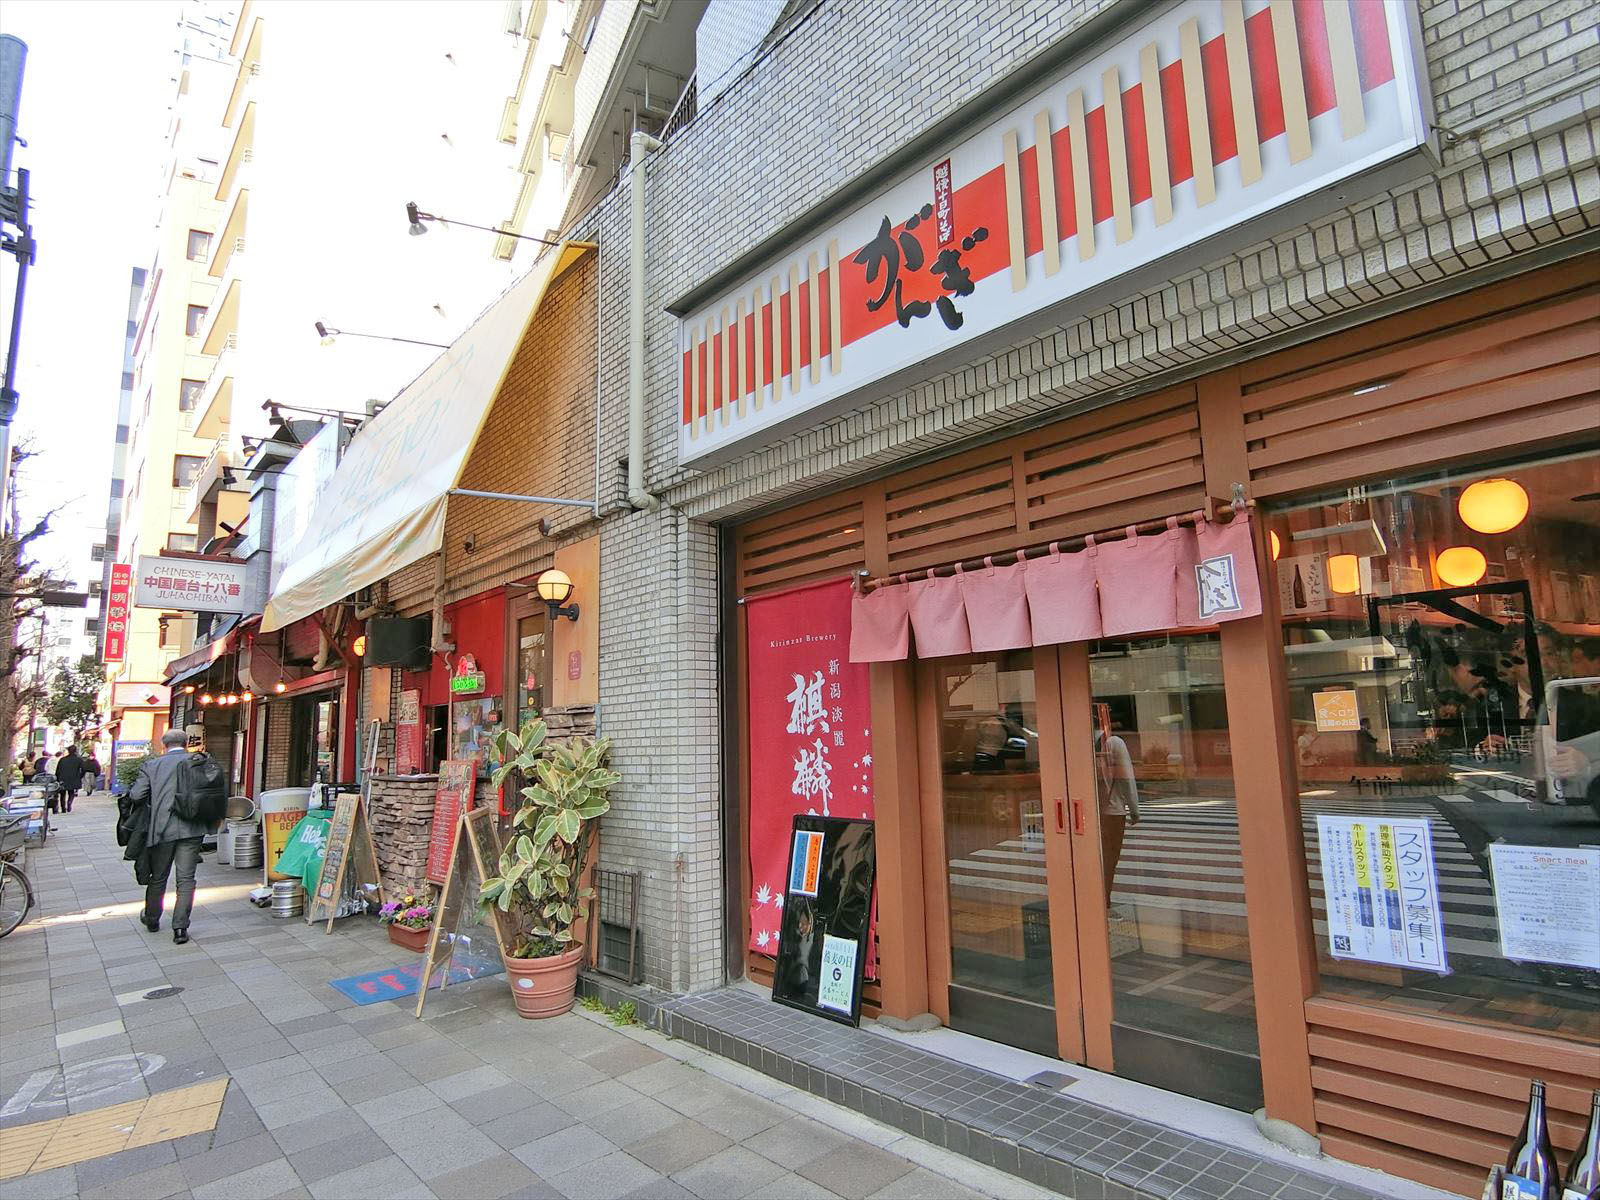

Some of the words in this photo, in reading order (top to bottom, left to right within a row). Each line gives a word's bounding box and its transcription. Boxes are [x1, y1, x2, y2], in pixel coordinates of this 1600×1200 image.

[853, 203, 988, 330] がんぎ
[154, 566, 235, 582] CHINESE-YATAI
[144, 576, 240, 596] 中国屋台十八番
[156, 590, 228, 604] JUHACHIBAN
[806, 633, 837, 642] Brewery
[828, 658, 845, 747] 新潟淡麗
[784, 670, 834, 817] 麒麟
[271, 811, 305, 823] LAGE
[1352, 824, 1366, 879] ホールスタッフ
[1532, 855, 1562, 864] Smart
